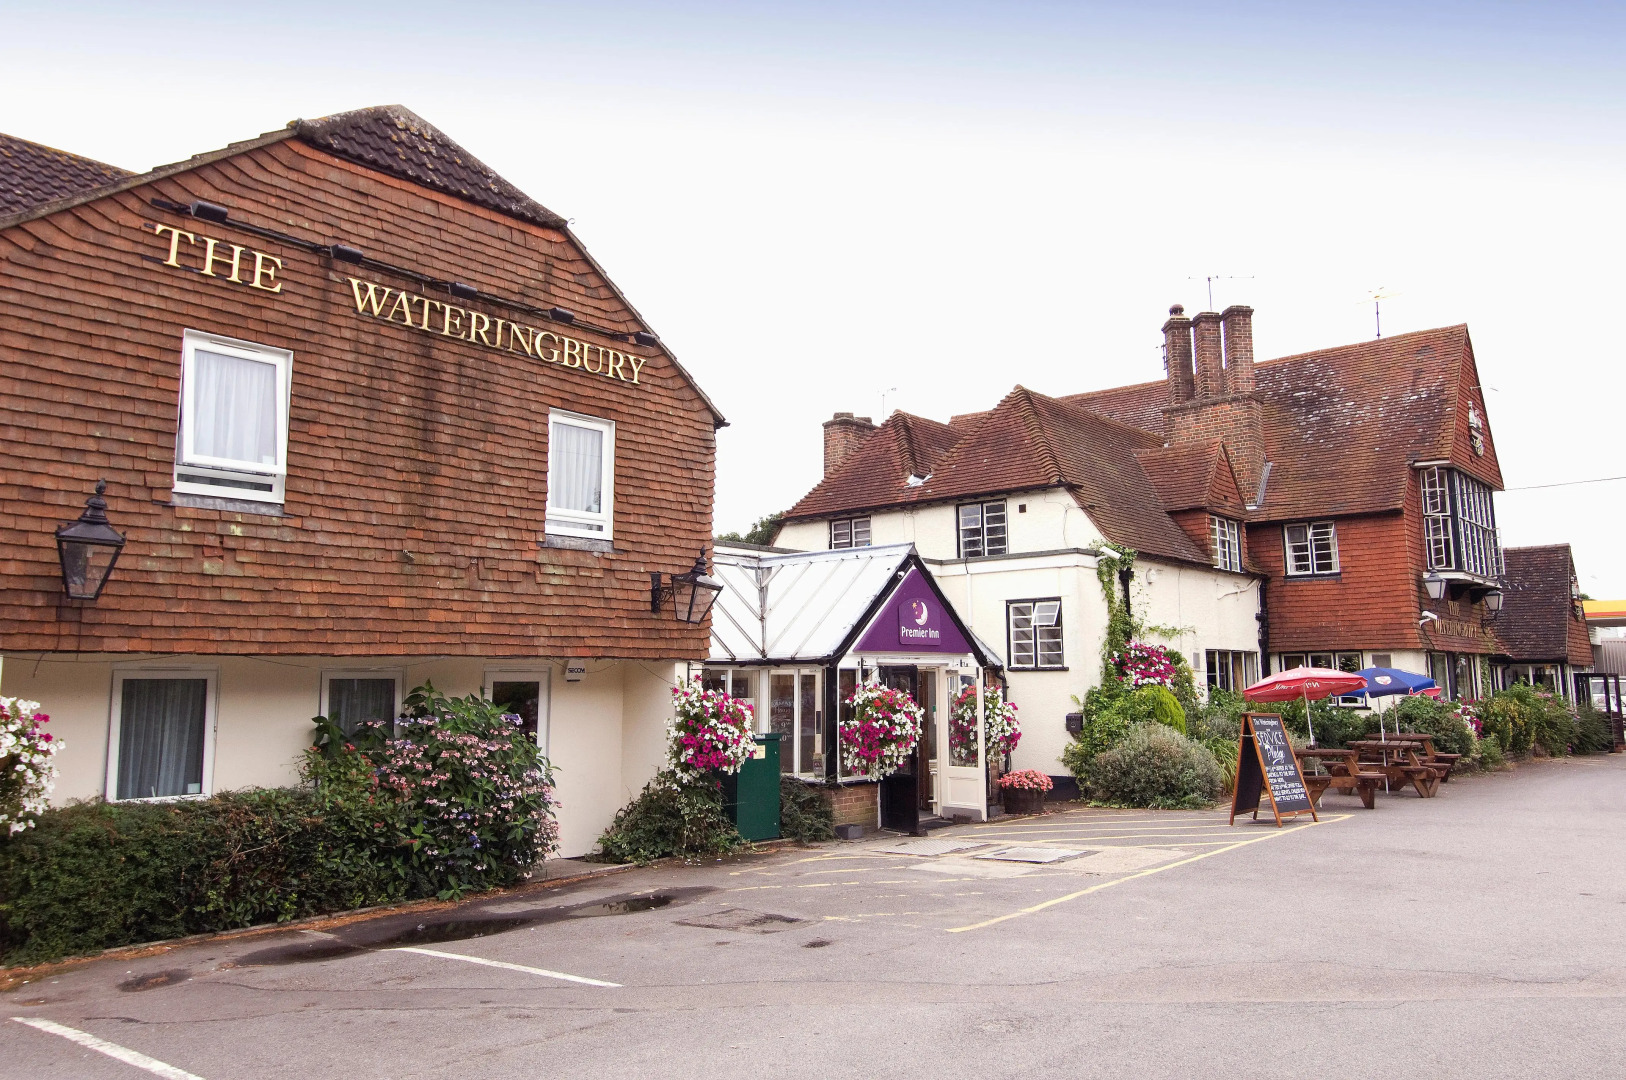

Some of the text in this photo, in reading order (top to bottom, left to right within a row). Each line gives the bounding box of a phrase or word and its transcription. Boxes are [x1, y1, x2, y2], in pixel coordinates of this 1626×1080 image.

[155, 223, 647, 385] THE WATERINGBURY
[901, 626, 940, 639] Premier Inn
[1255, 731, 1286, 746] SERVICE
